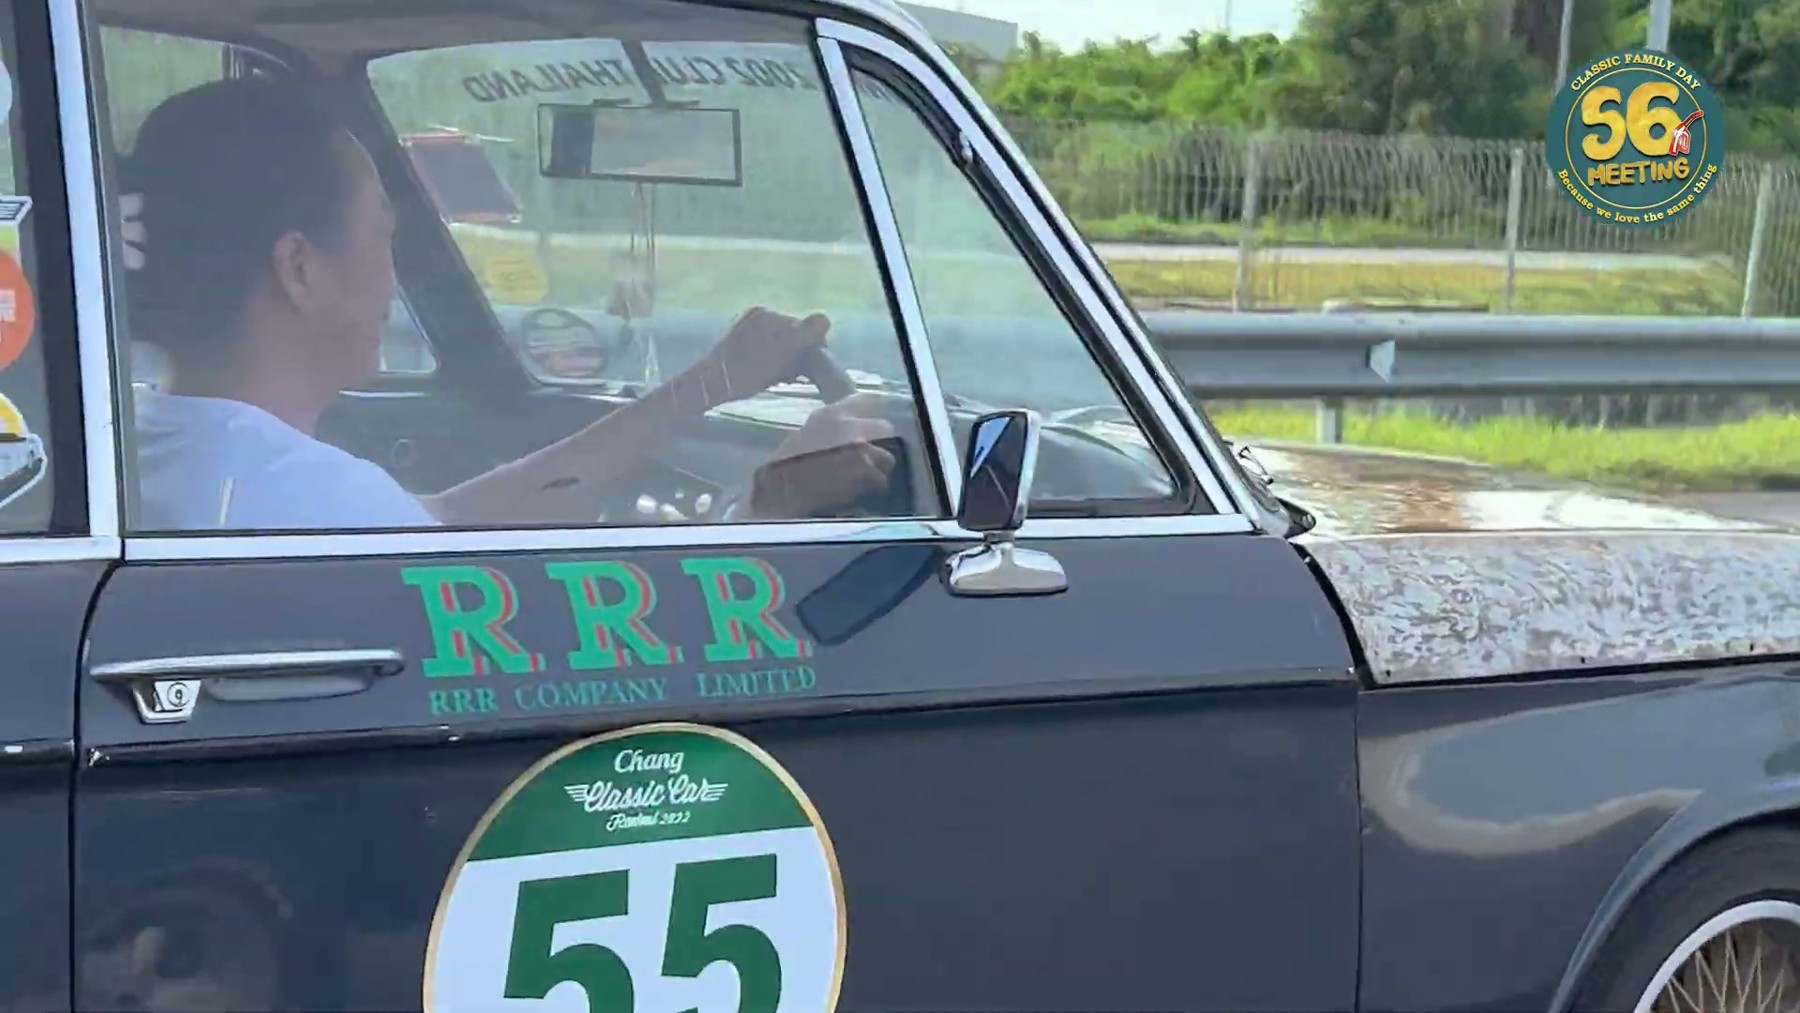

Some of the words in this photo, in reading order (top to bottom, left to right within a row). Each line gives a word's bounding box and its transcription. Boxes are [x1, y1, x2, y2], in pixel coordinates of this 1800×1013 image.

[428, 688, 498, 715] RRR
[514, 676, 668, 710] COMPANY
[696, 665, 816, 698] LIMITED
[614, 749, 684, 774] Chang
[584, 780, 666, 813] Classic
[667, 773, 711, 805] Car
[504, 854, 782, 1013] 55
